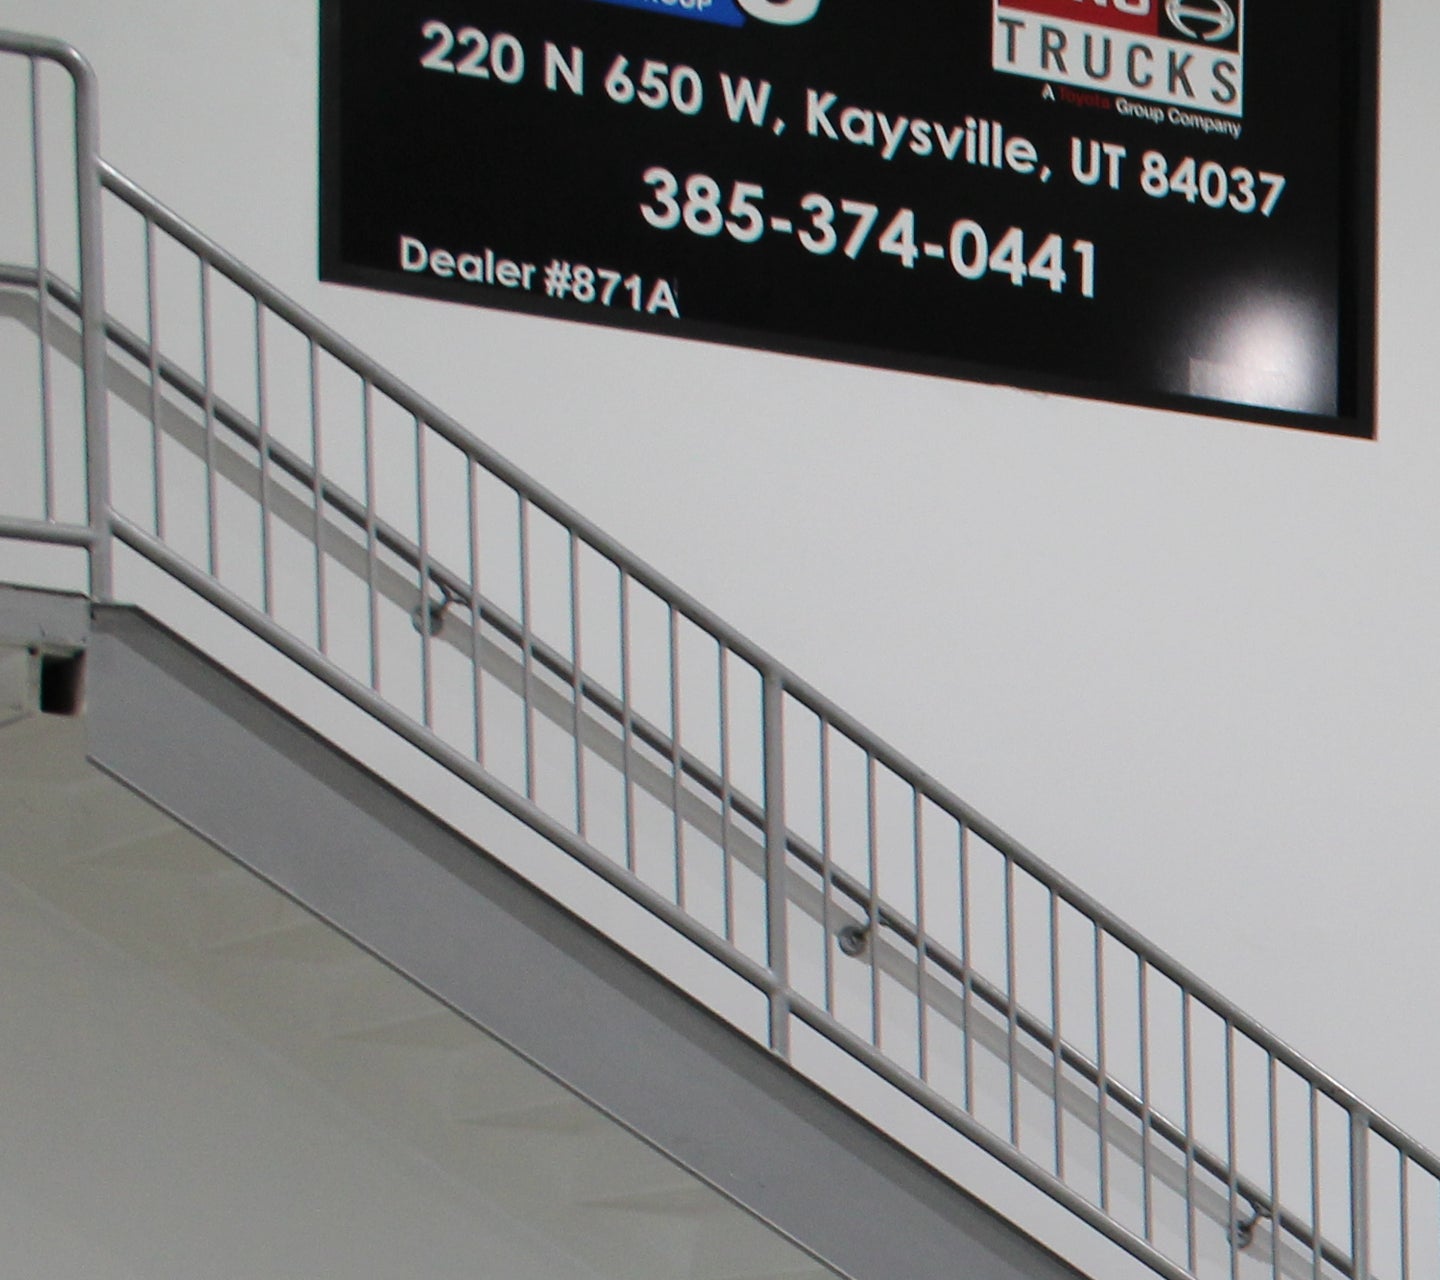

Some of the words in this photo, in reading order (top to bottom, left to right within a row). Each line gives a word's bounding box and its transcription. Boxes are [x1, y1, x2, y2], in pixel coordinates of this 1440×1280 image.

[997, 16, 1237, 104] TRUCKS
[420, 20, 525, 84] 220
[544, 41, 584, 95] N
[604, 55, 703, 116] 650
[719, 72, 786, 136] W,
[805, 87, 1051, 183] Kaysville,
[1071, 137, 1126, 190] UT
[1140, 149, 1286, 218] 84037
[1041, 82, 1055, 101] A
[1115, 97, 1164, 123] Group
[1167, 107, 1242, 139] Company
[639, 166, 1095, 298] 385-374-0441
[400, 235, 536, 290] Dealer
[544, 259, 680, 318] #871A
